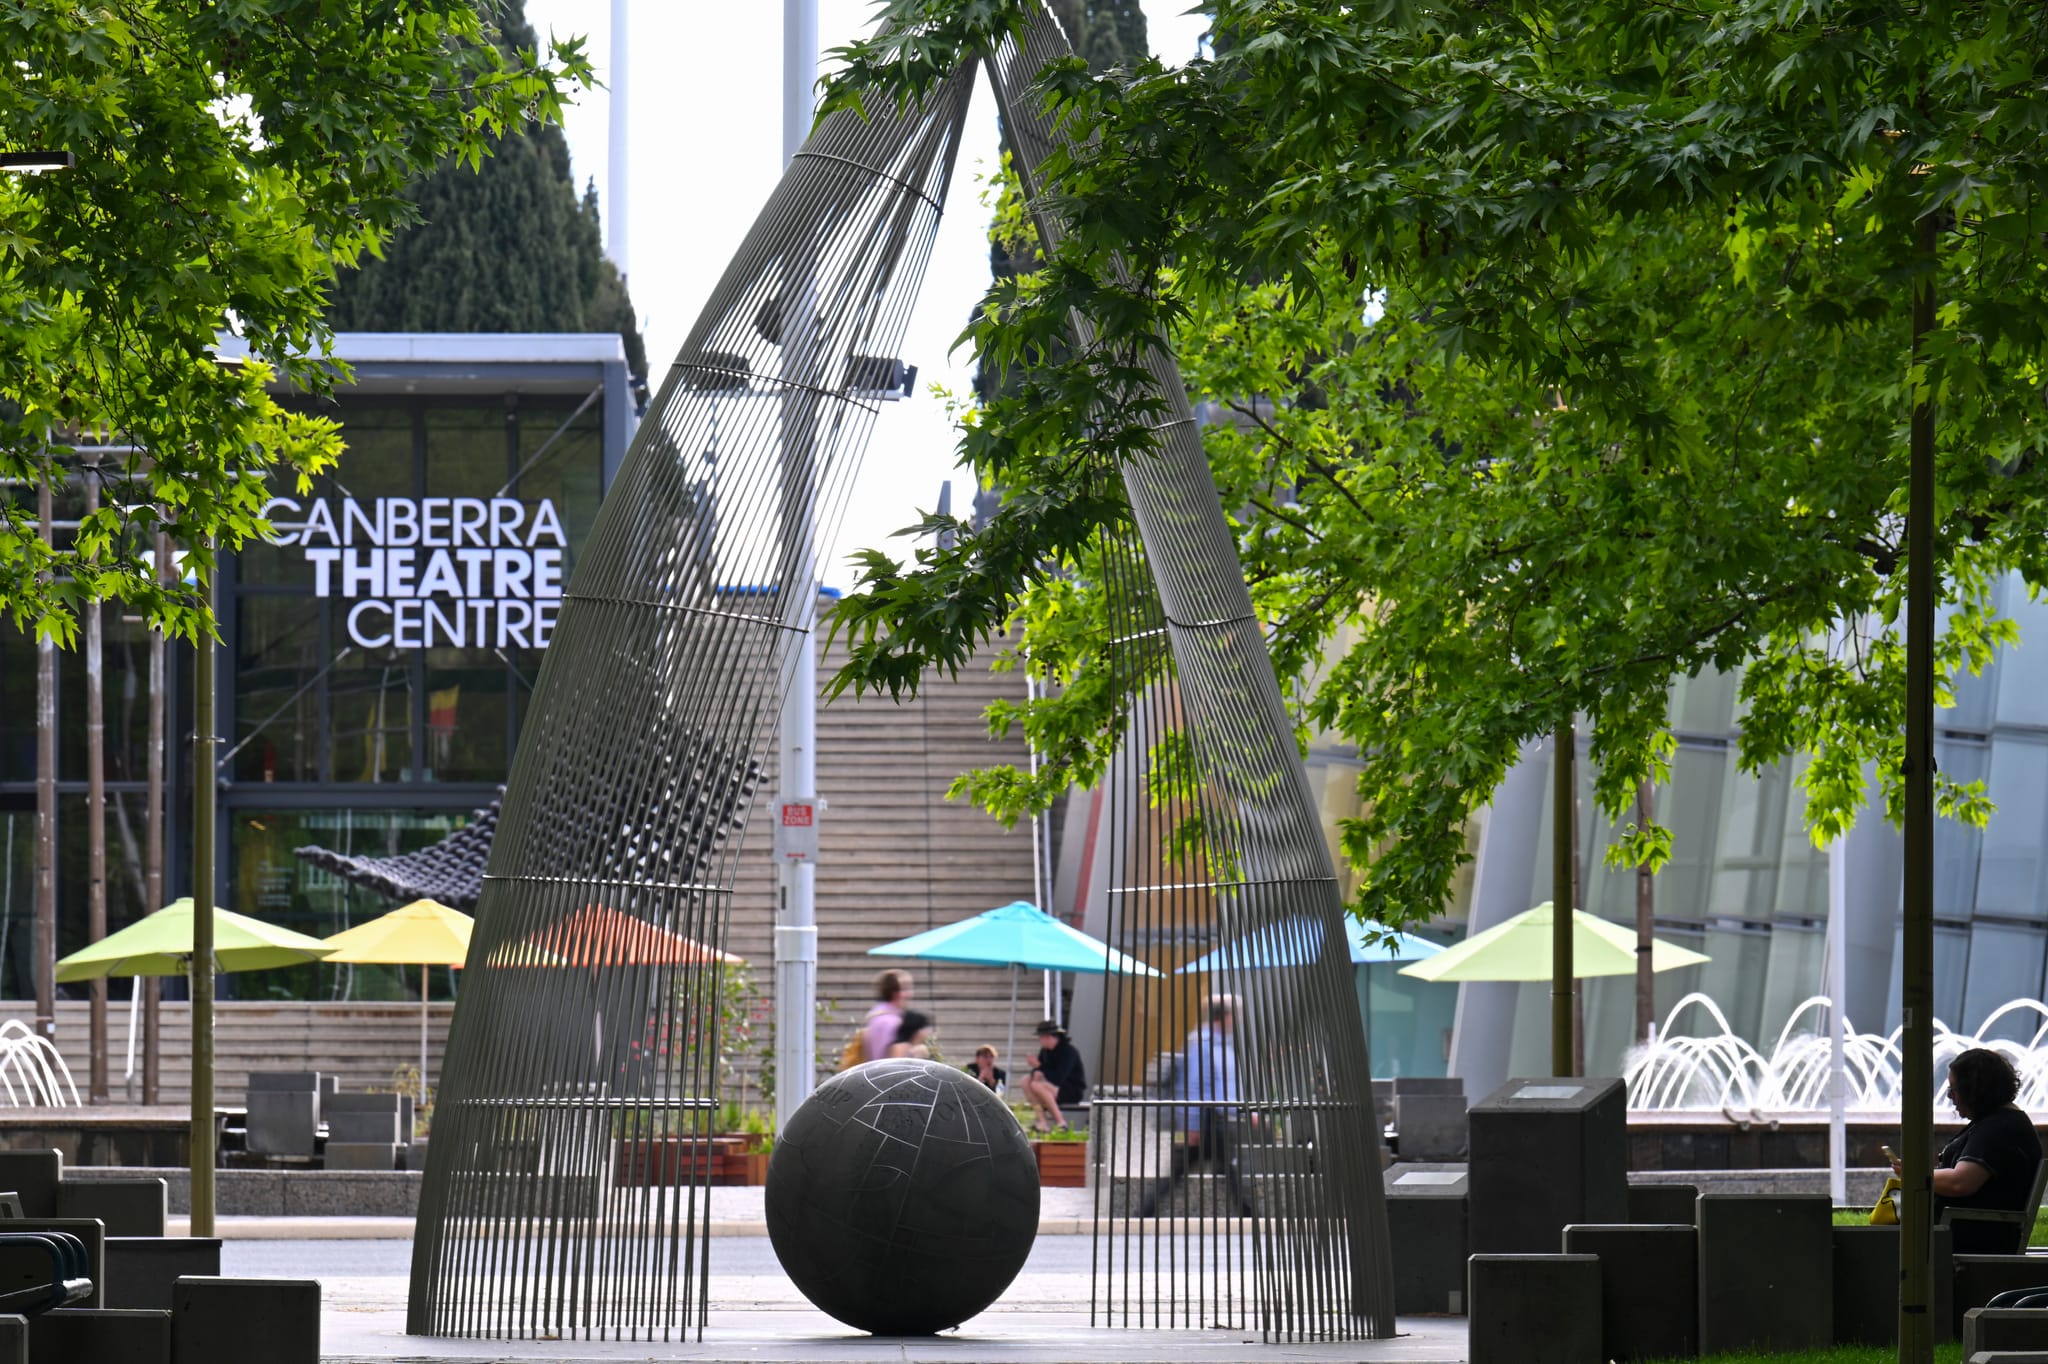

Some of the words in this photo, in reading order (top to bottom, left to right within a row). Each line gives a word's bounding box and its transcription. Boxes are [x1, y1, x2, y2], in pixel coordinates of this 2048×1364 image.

[257, 497, 567, 547] CANBERRA
[305, 548, 562, 598] THEATRE
[348, 599, 562, 649] CENTRE
[784, 816, 810, 825] ZONE
[787, 806, 806, 815] BUS
